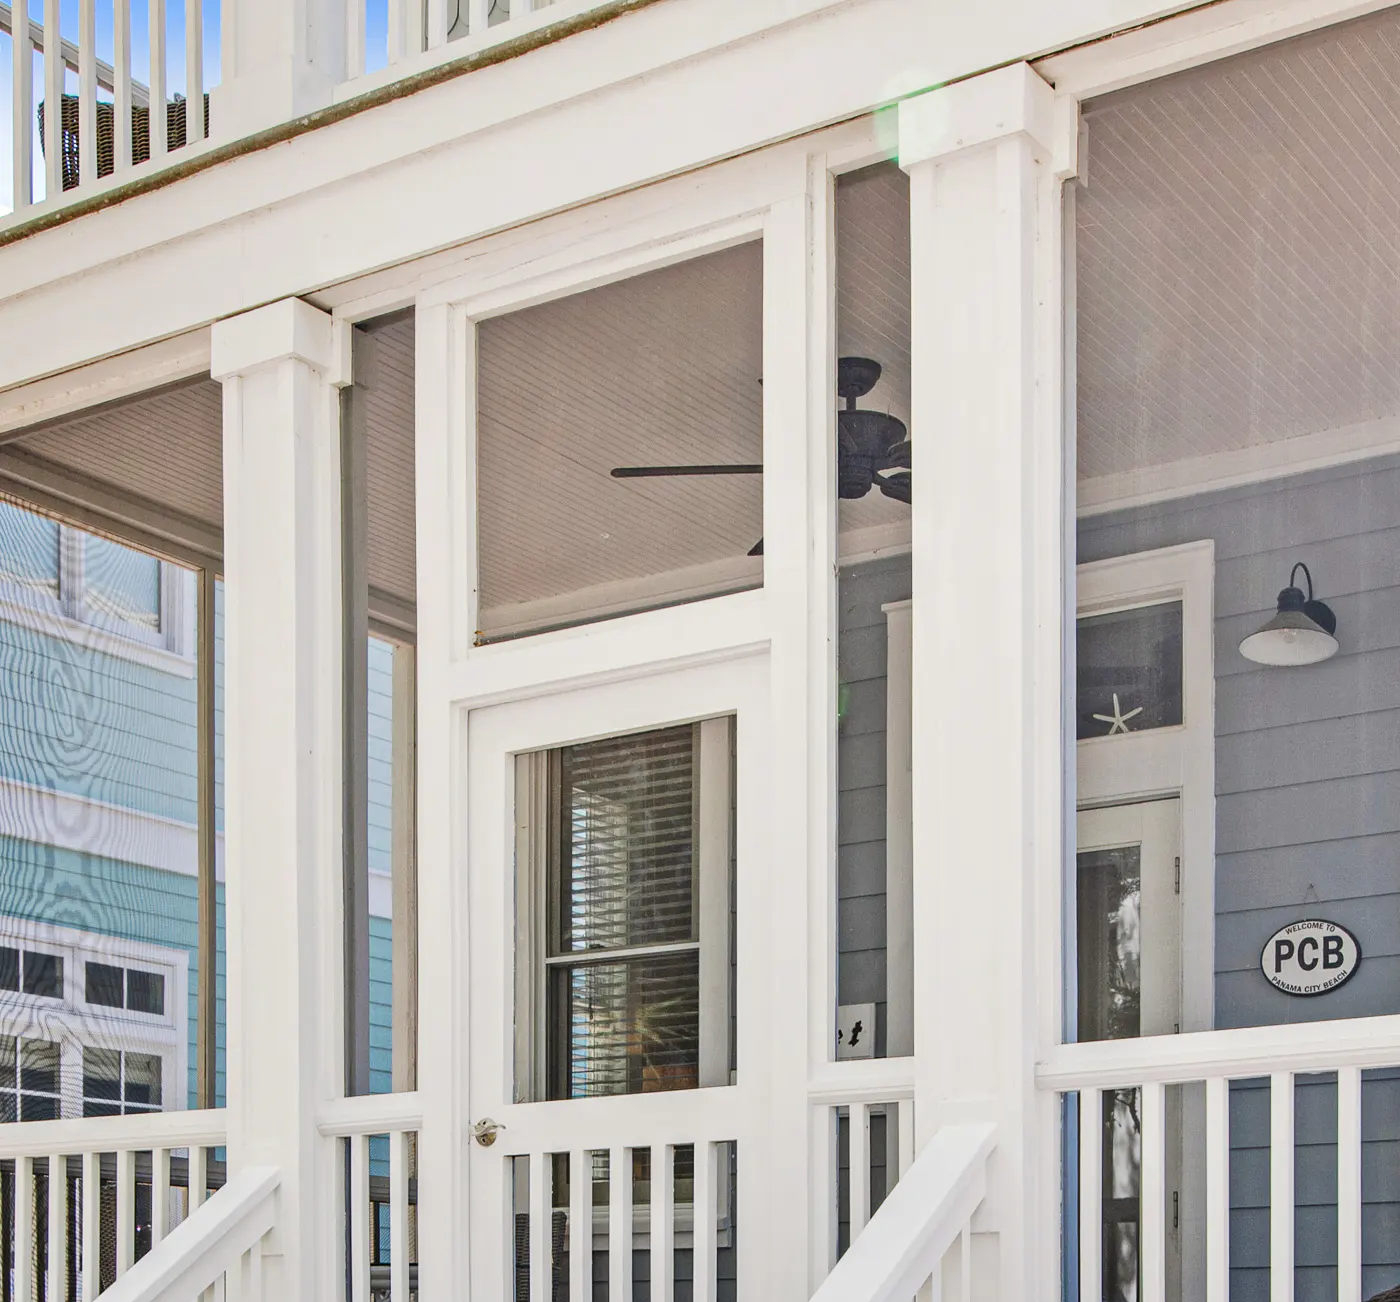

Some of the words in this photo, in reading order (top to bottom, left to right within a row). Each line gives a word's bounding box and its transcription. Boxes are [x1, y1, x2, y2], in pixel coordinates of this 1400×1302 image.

[1285, 922, 1324, 935] WELCOME
[1326, 923, 1336, 933] TO
[1274, 935, 1344, 973] PCB
[1272, 976, 1302, 993] PANAMA
[1304, 984, 1321, 993] CITY
[1323, 969, 1348, 989] BEACH
